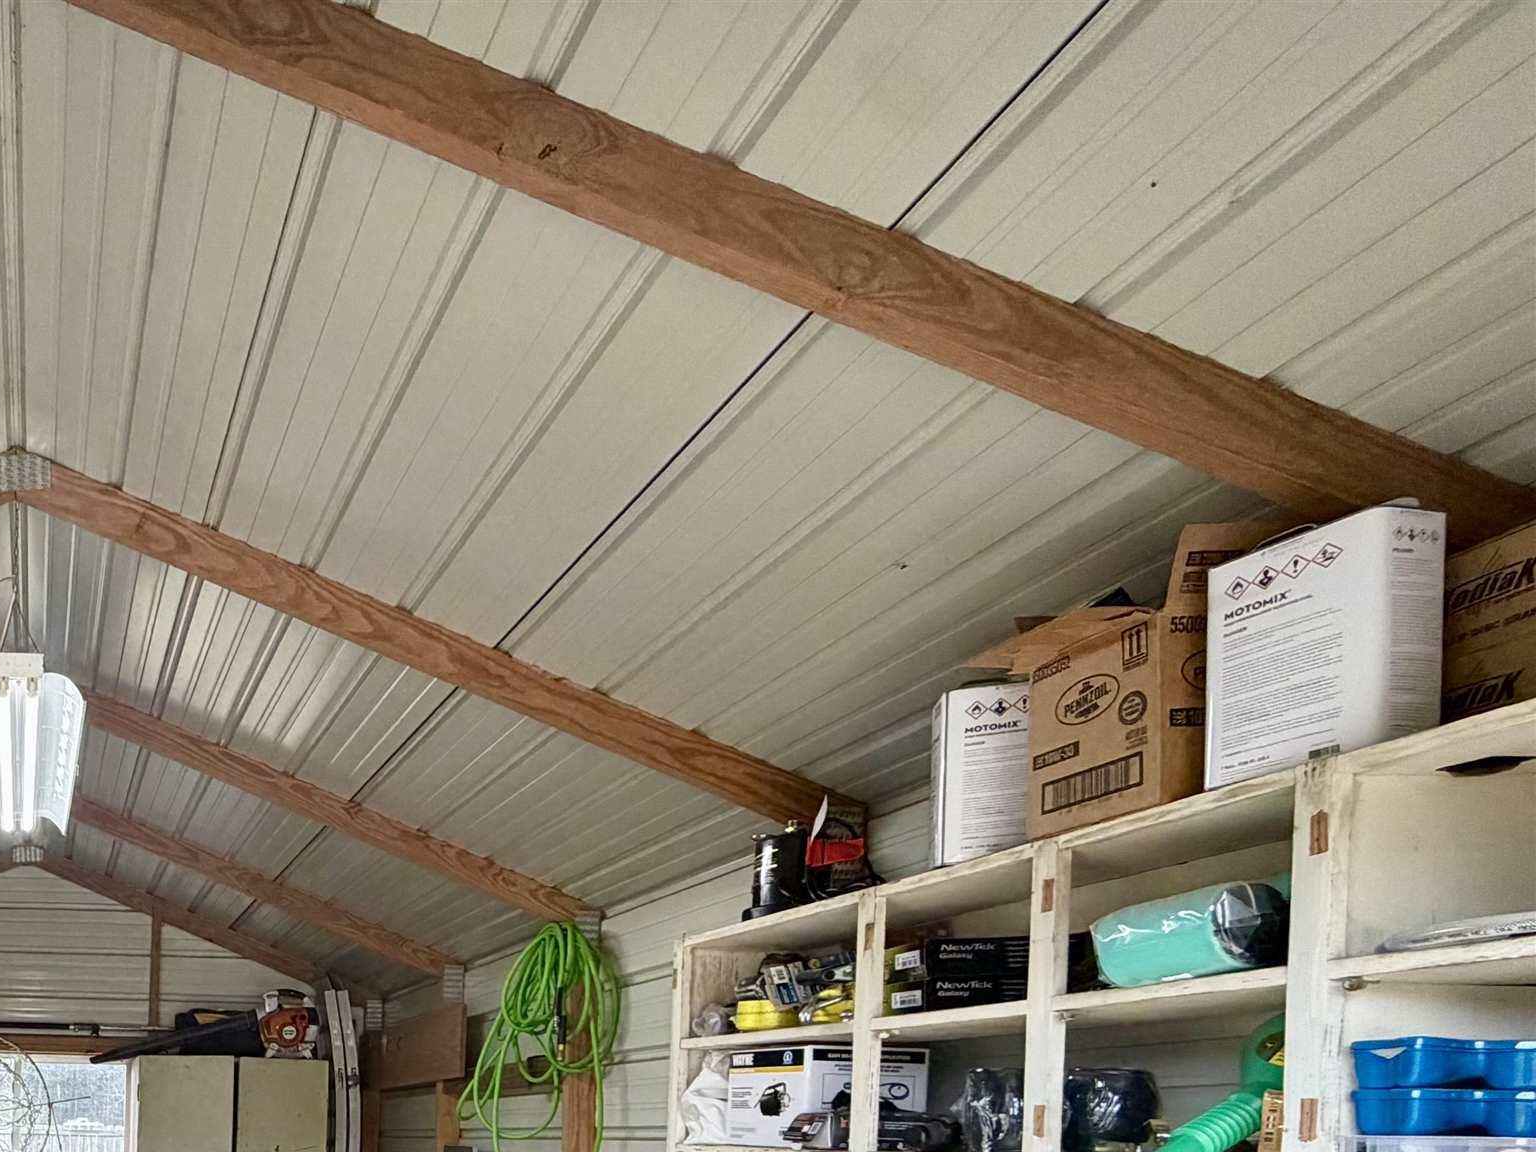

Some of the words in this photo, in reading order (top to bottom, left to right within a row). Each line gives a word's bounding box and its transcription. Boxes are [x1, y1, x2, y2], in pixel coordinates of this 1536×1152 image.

[1224, 590, 1288, 620] MOTOMIX
[1064, 681, 1112, 718] PENNZOIL
[964, 720, 1020, 734] MOTOMIX
[940, 943, 997, 952] NewTek
[939, 952, 973, 960] Galaxy
[936, 980, 993, 989] NewTek
